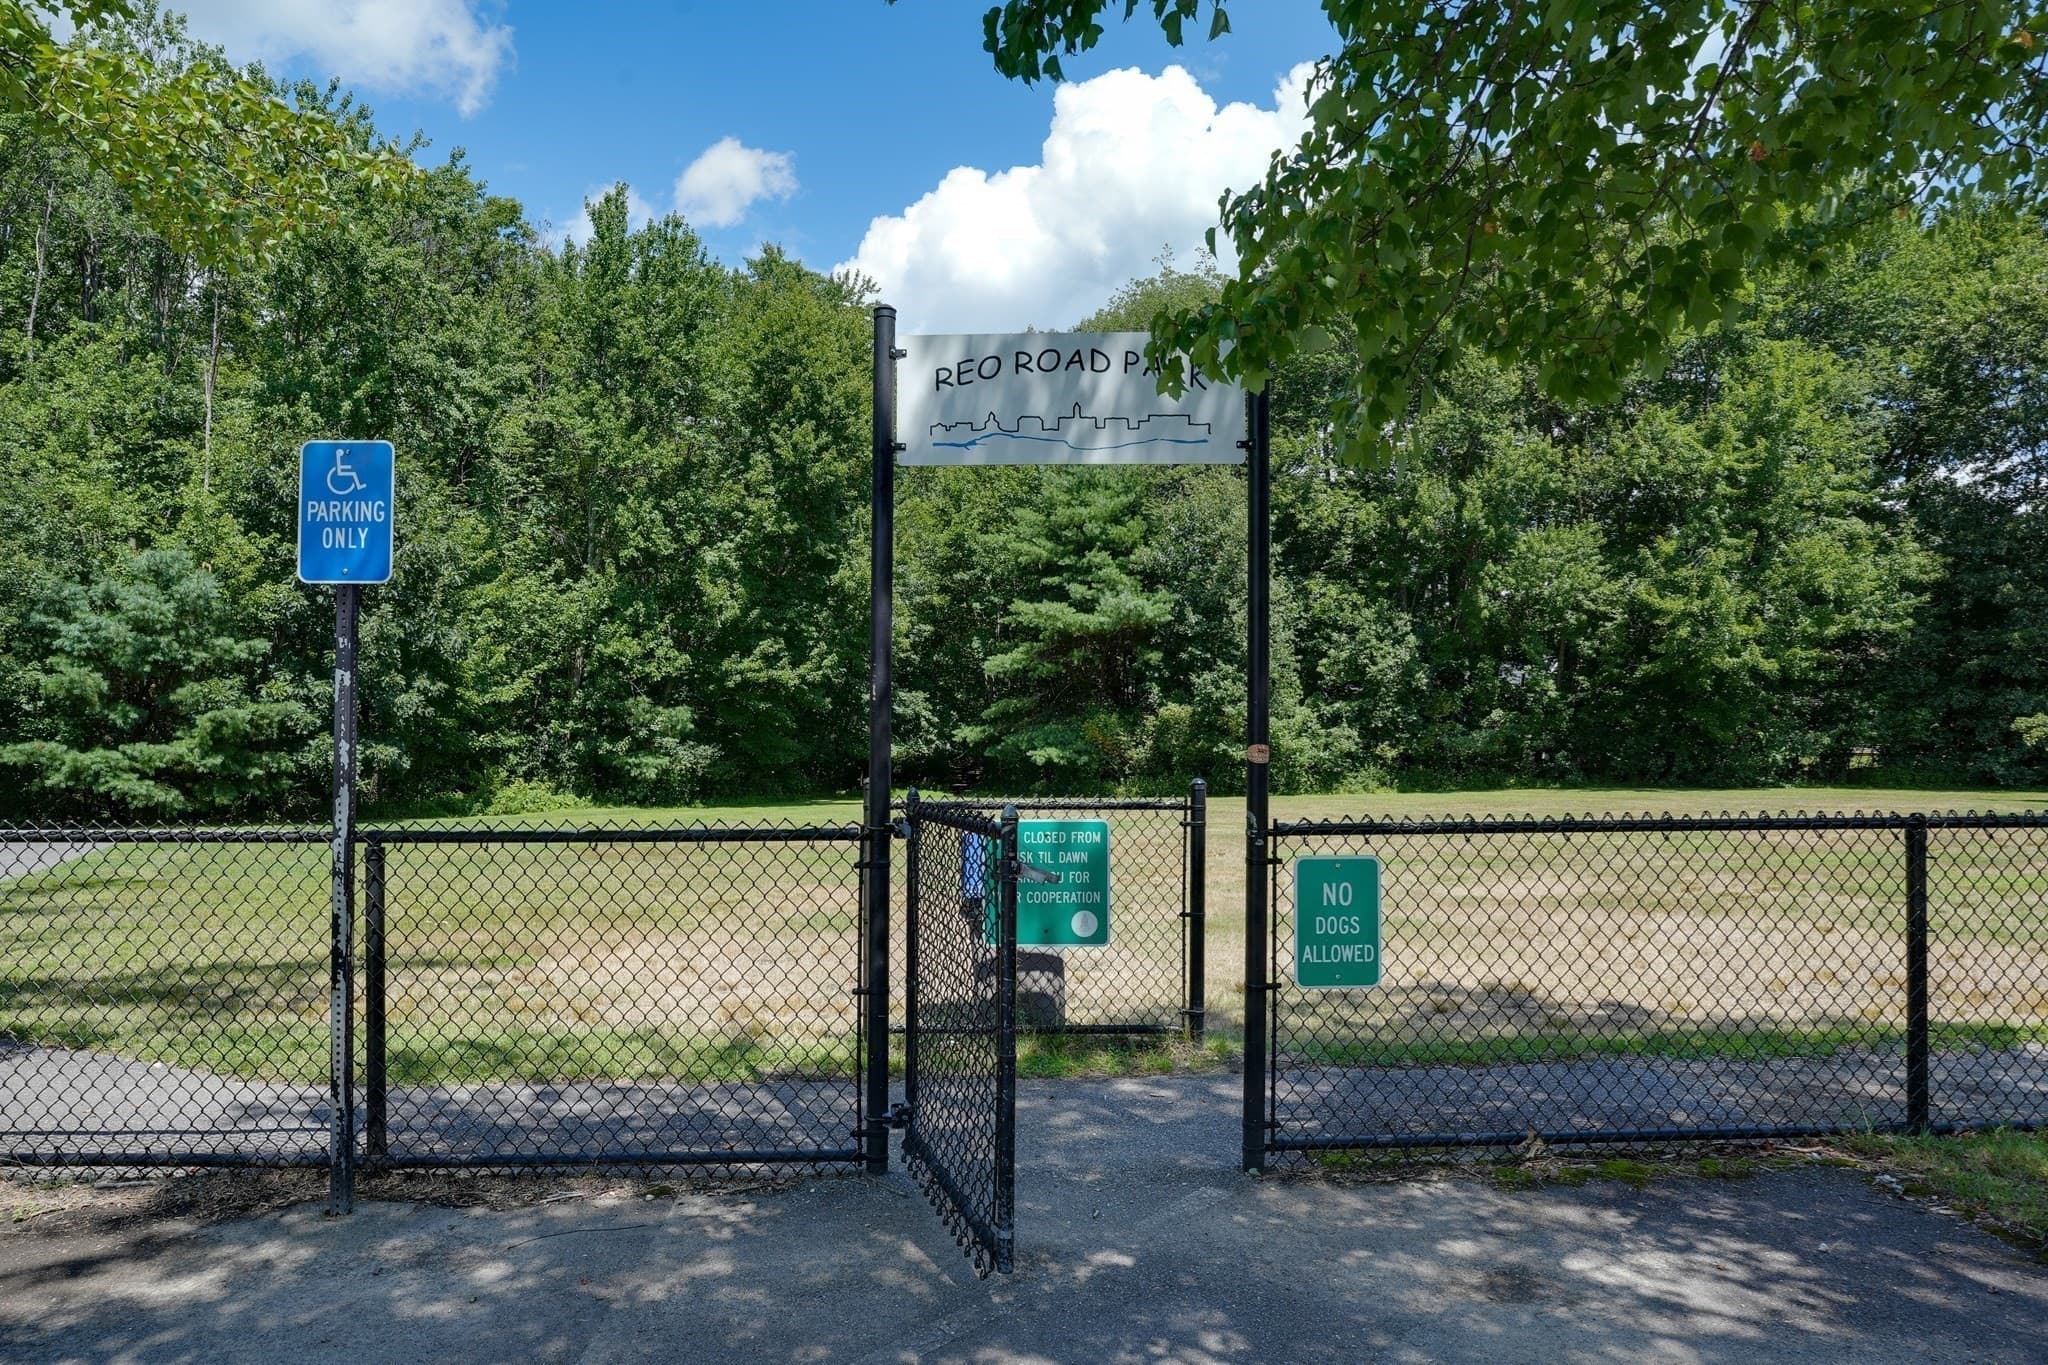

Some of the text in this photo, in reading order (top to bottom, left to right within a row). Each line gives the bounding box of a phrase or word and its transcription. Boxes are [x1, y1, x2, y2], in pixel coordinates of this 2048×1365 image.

[935, 348, 1207, 391] REO ROAD PAK
[307, 500, 385, 522] PARKING
[322, 527, 369, 549] ONLY
[1023, 831, 1101, 844] CLOSED FROM
[1038, 851, 1054, 864] TIL
[1058, 851, 1088, 864] DAWN
[1069, 871, 1090, 884] FOR
[1026, 891, 1101, 904] COOPERATION
[1323, 882, 1352, 906] NO
[1315, 916, 1360, 934] DOGS
[1302, 944, 1374, 963] ALLOWED
